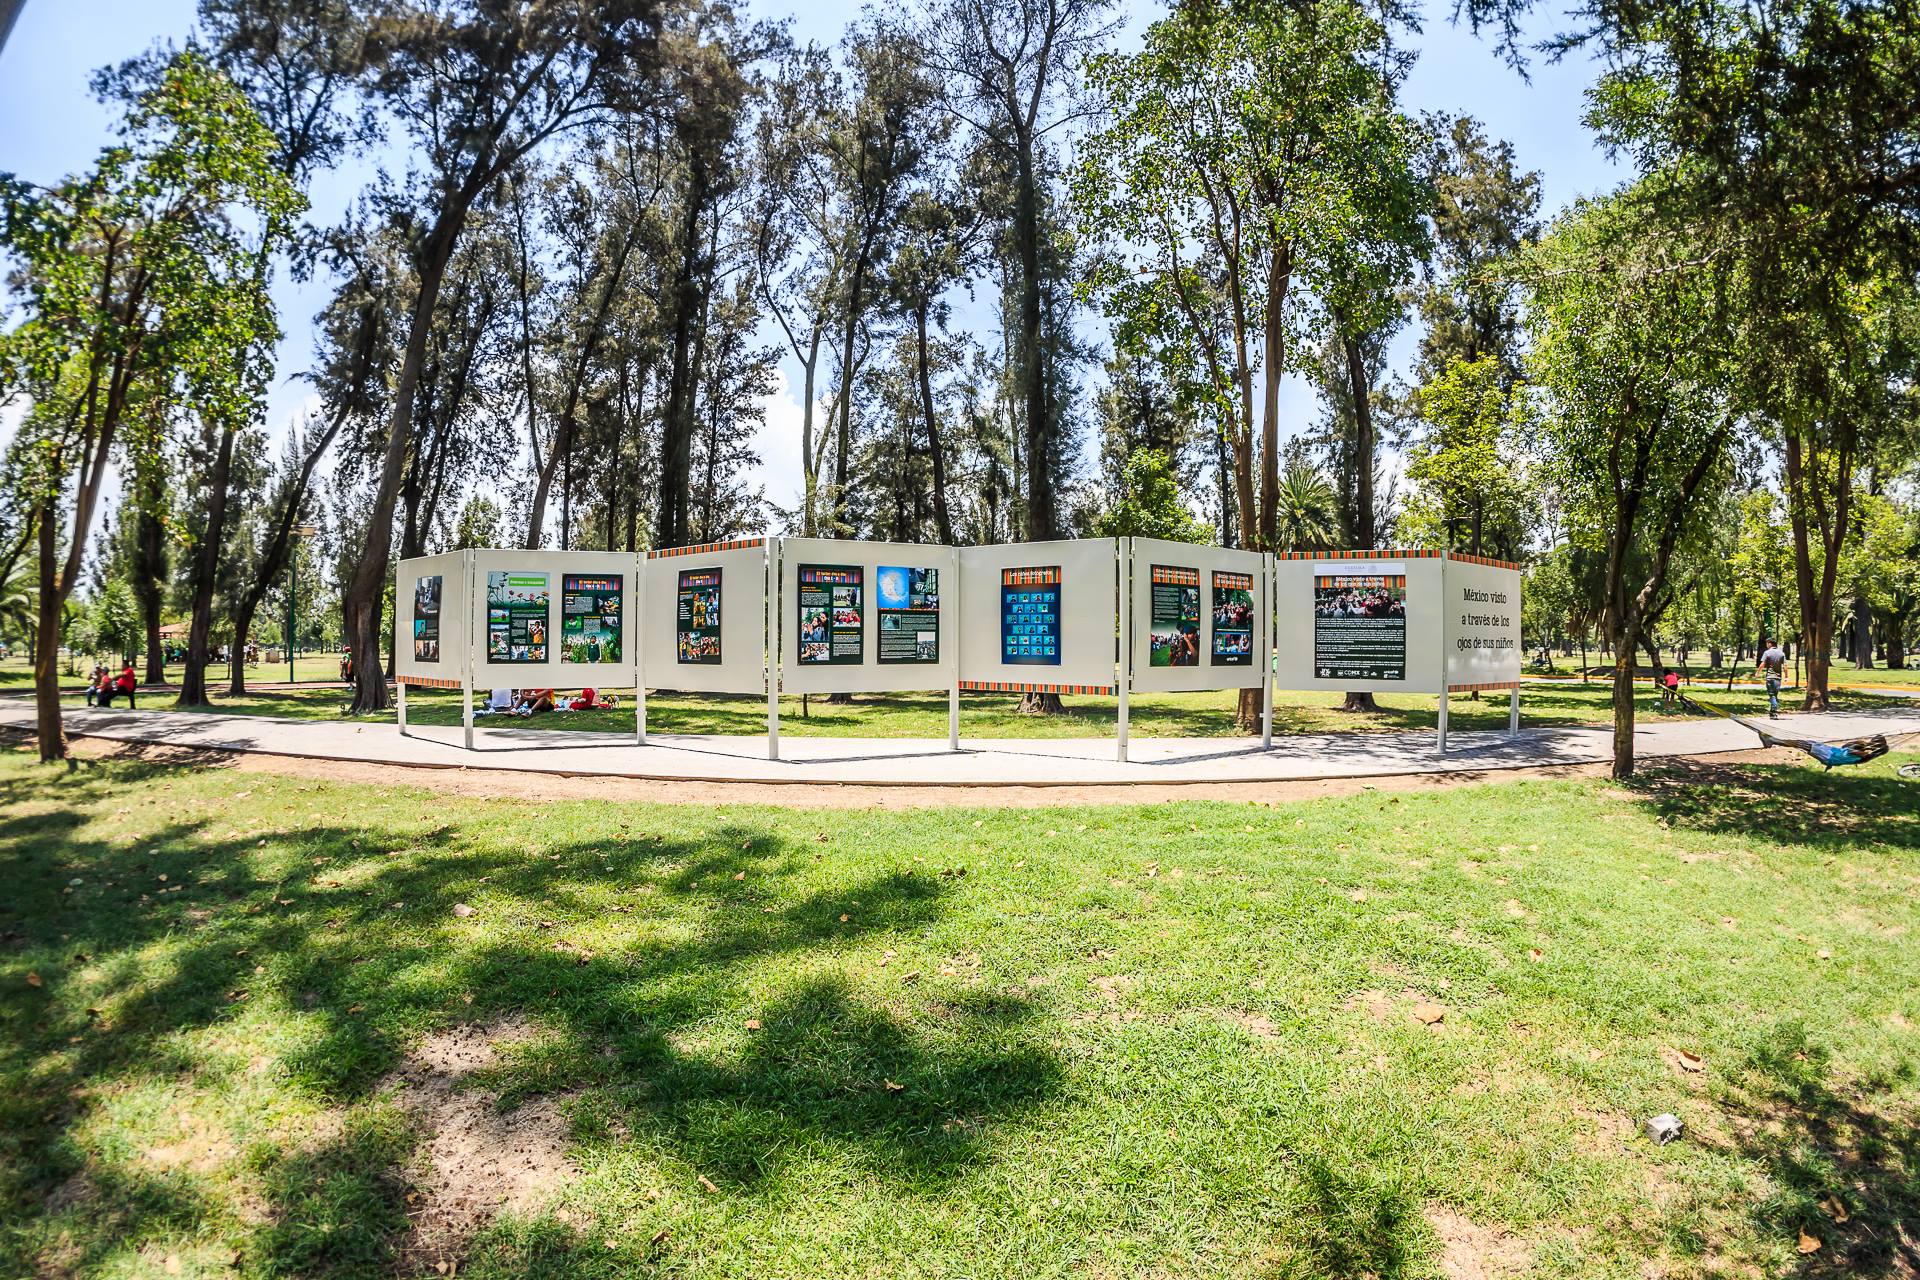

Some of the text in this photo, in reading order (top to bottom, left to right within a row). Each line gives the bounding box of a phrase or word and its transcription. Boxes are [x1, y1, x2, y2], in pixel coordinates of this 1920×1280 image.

[1463, 588, 1507, 604] México visto
[1461, 613, 1510, 627] a través de los
[1457, 637, 1514, 651] ojos de sus niños
